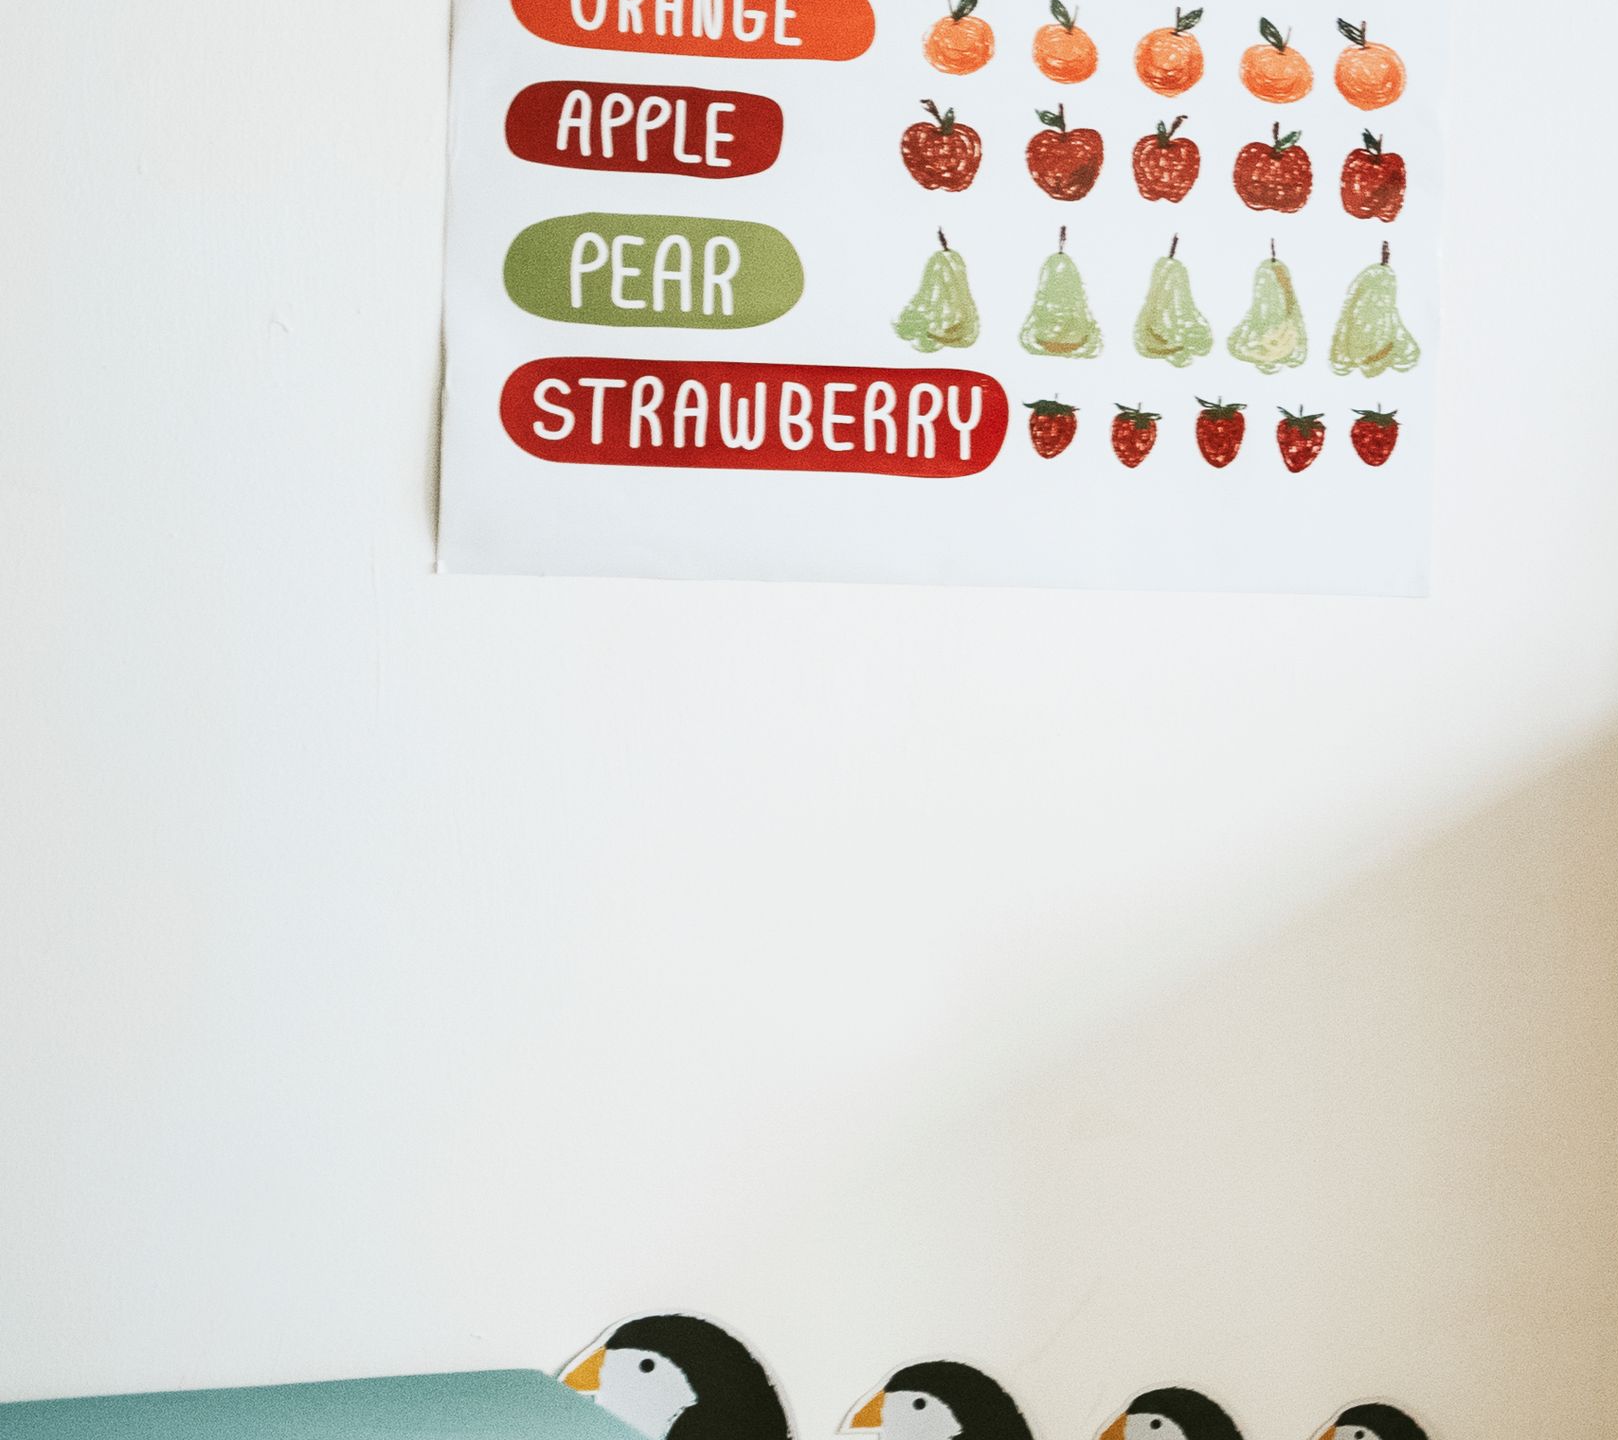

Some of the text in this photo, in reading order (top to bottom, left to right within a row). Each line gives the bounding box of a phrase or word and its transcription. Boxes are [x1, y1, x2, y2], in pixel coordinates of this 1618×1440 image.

[556, 89, 736, 168] APPLE
[569, 231, 742, 317] PEAR
[532, 377, 986, 460] STRAWBERRY
